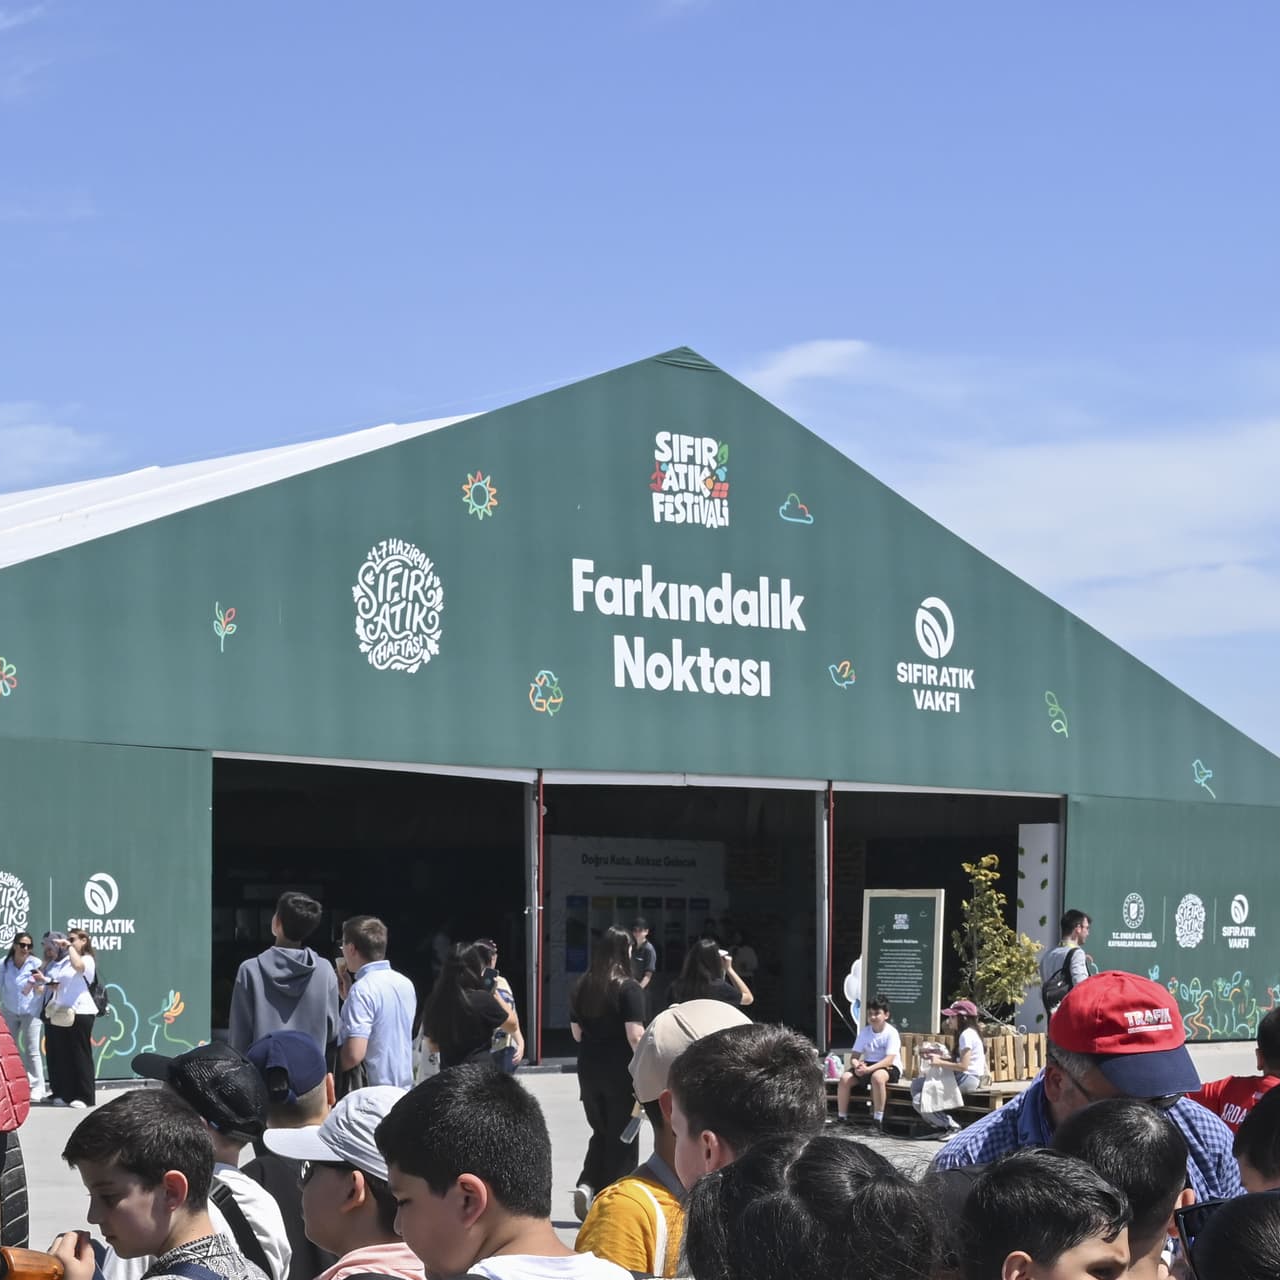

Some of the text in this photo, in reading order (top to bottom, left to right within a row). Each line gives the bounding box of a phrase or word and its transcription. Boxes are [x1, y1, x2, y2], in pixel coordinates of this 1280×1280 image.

[655, 431, 718, 470] SIFIR
[661, 463, 711, 498] ATIK
[652, 492, 729, 528] FESTİVALİ
[388, 538, 434, 575] HAZİRAN
[358, 558, 437, 619] SIFIR
[572, 558, 806, 631] Farkındalık
[366, 600, 439, 641] ATIK
[614, 635, 771, 697] Noktası
[897, 662, 975, 689] SIFIR ATIK
[913, 689, 960, 713] VAKFI
[87, 936, 122, 950] AKFI
[104, 919, 135, 933] ATIK
[1222, 926, 1256, 937] SIFIR ATIK
[1228, 938, 1249, 949] VAKFI
